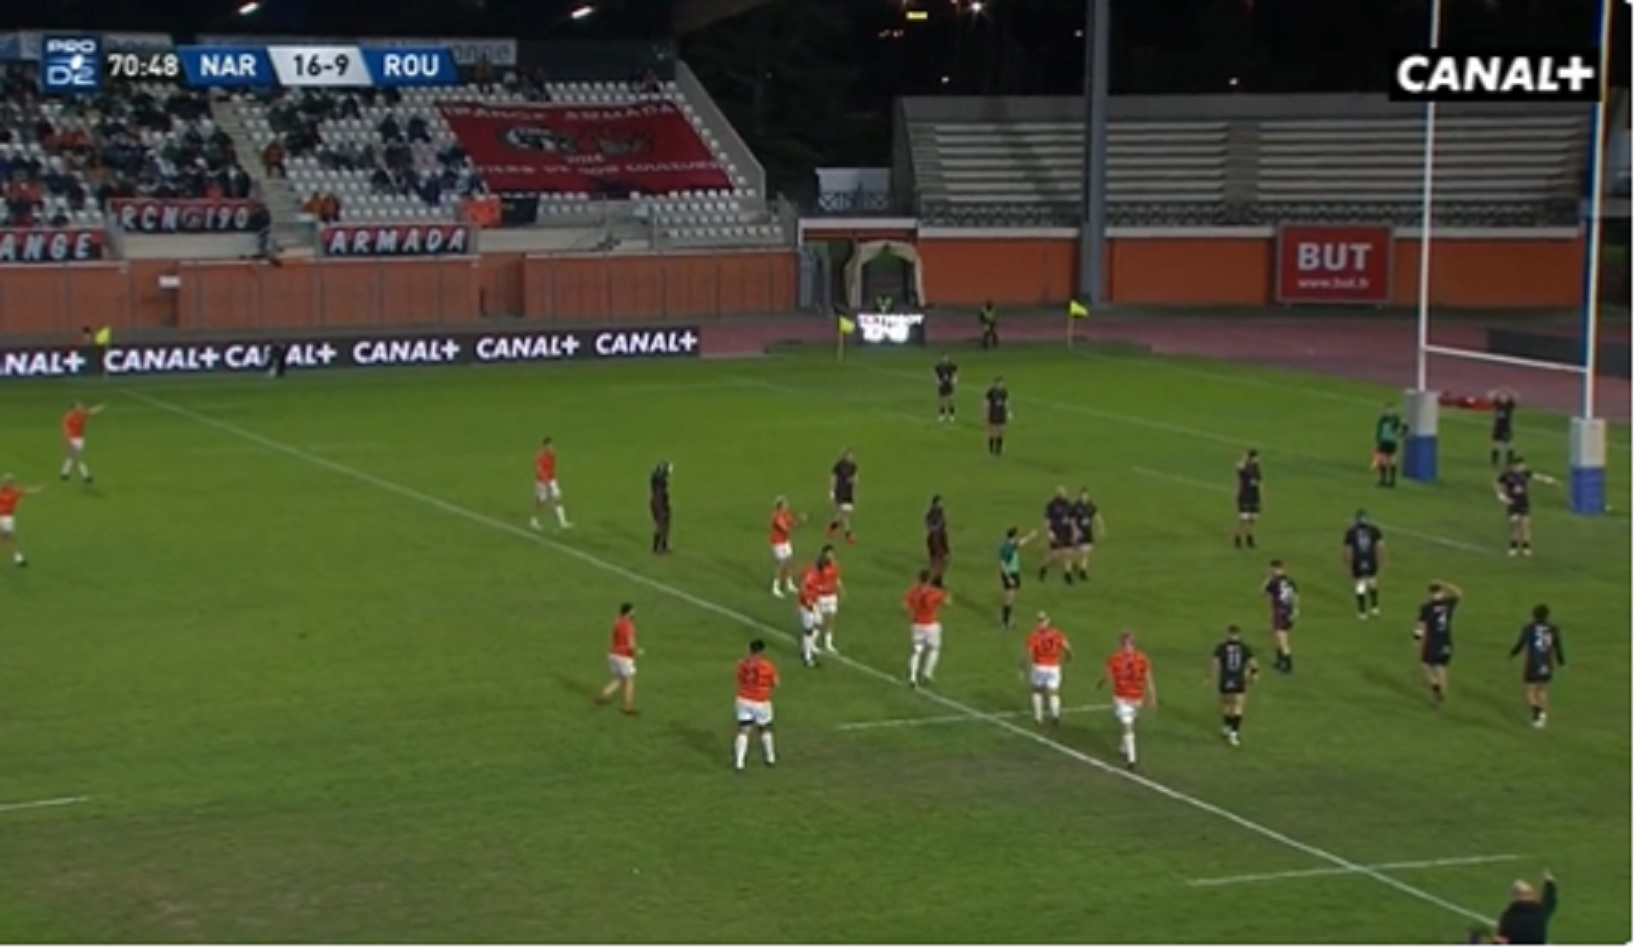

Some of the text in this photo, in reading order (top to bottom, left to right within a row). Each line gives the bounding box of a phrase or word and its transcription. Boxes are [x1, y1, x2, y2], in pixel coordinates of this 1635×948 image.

[121, 203, 178, 230] RCN
[329, 225, 467, 254] ARMADA
[1297, 242, 1372, 271] BUT
[353, 338, 460, 364] CANAL+
[476, 334, 580, 361] CANAL+
[595, 330, 698, 356] CANAL+
[0, 350, 86, 374] NAL+
[104, 346, 219, 372] CANAL+
